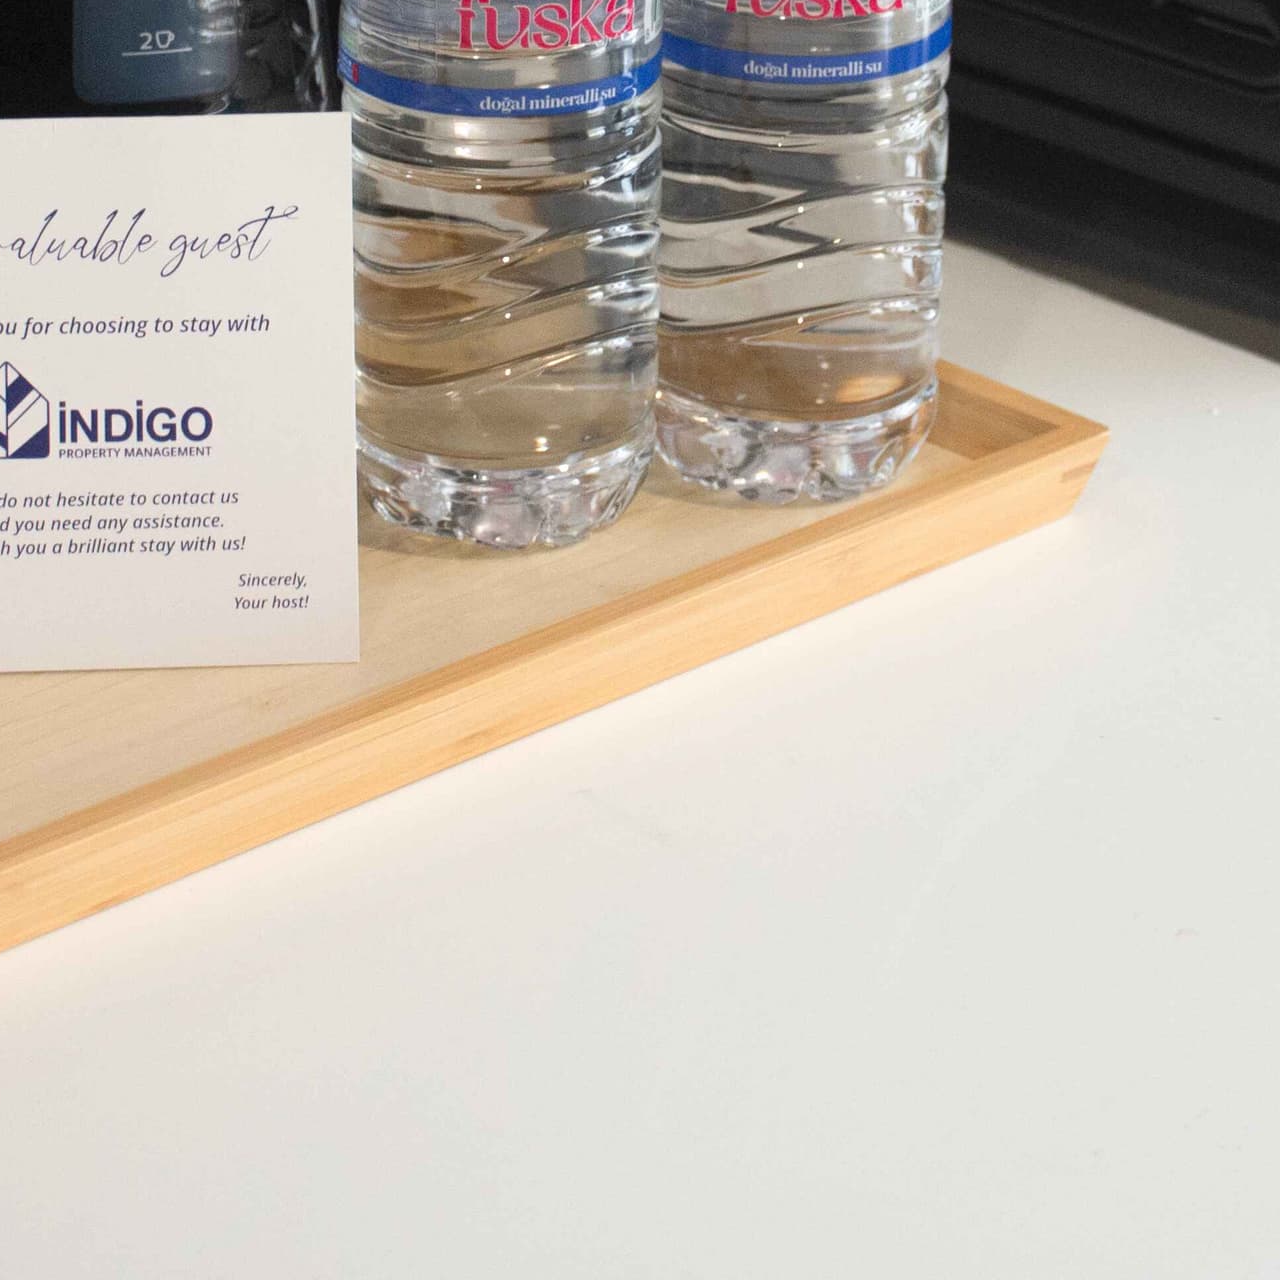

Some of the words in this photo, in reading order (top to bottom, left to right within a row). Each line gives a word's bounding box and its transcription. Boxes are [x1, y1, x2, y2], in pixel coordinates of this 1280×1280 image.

[139, 31, 154, 51] 2
[743, 59, 788, 79] doğal
[790, 61, 864, 79] mineralli
[865, 61, 883, 74] su
[478, 95, 526, 113] doğal
[528, 87, 600, 111] mineralli
[600, 87, 617, 100] su
[159, 204, 299, 278] guest
[20, 316, 54, 341] for
[59, 315, 149, 339] choosing
[154, 317, 174, 334] to
[179, 316, 223, 338] stay
[227, 313, 270, 333] with
[58, 447, 121, 459] PROPERTY
[123, 445, 212, 458] MANAGEMENT
[22, 493, 52, 509] not
[56, 491, 125, 508] hesitate
[130, 492, 147, 506] to
[152, 490, 216, 506] contact
[220, 492, 239, 505] us
[13, 519, 46, 536] you
[50, 514, 93, 531] need
[97, 517, 129, 534] any
[132, 513, 224, 529] assistance.
[14, 543, 47, 560] you
[51, 543, 63, 555] a
[67, 537, 136, 555] brilliant
[139, 538, 176, 557] stay
[180, 535, 217, 552] with
[221, 535, 247, 551] us!
[238, 571, 307, 590] Sincerely,
[234, 596, 268, 610] Your
[271, 594, 310, 609] host!
